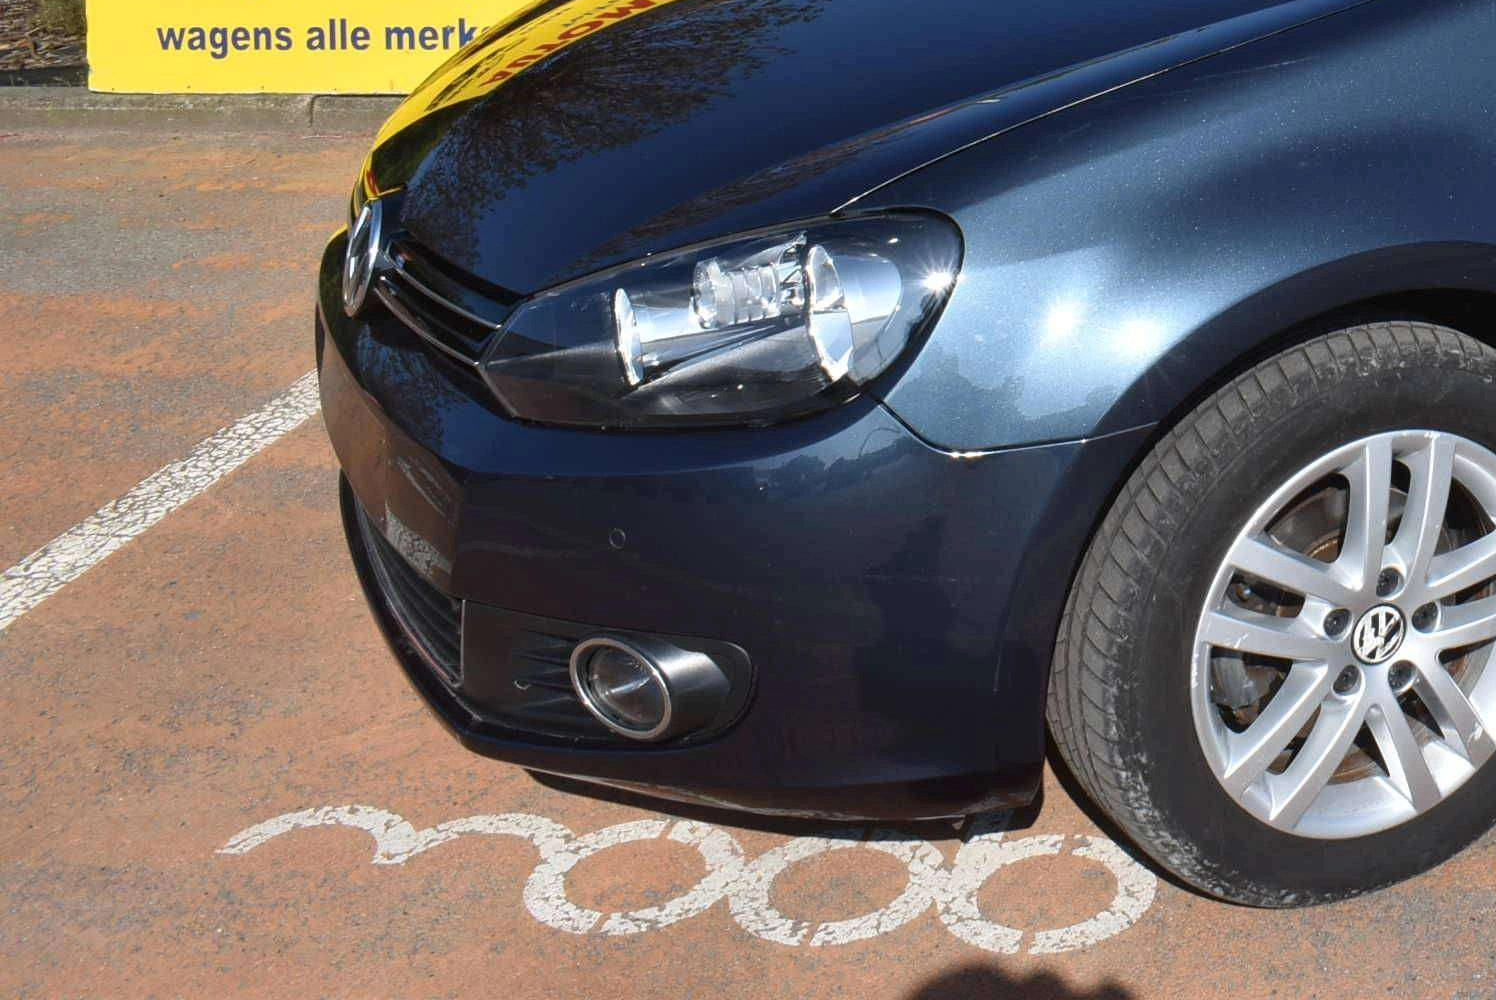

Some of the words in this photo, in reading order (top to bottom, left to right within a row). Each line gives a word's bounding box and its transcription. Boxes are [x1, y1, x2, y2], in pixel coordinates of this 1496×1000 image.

[157, 27, 293, 60] wagens
[307, 18, 371, 51] alle
[385, 17, 490, 52] merk
